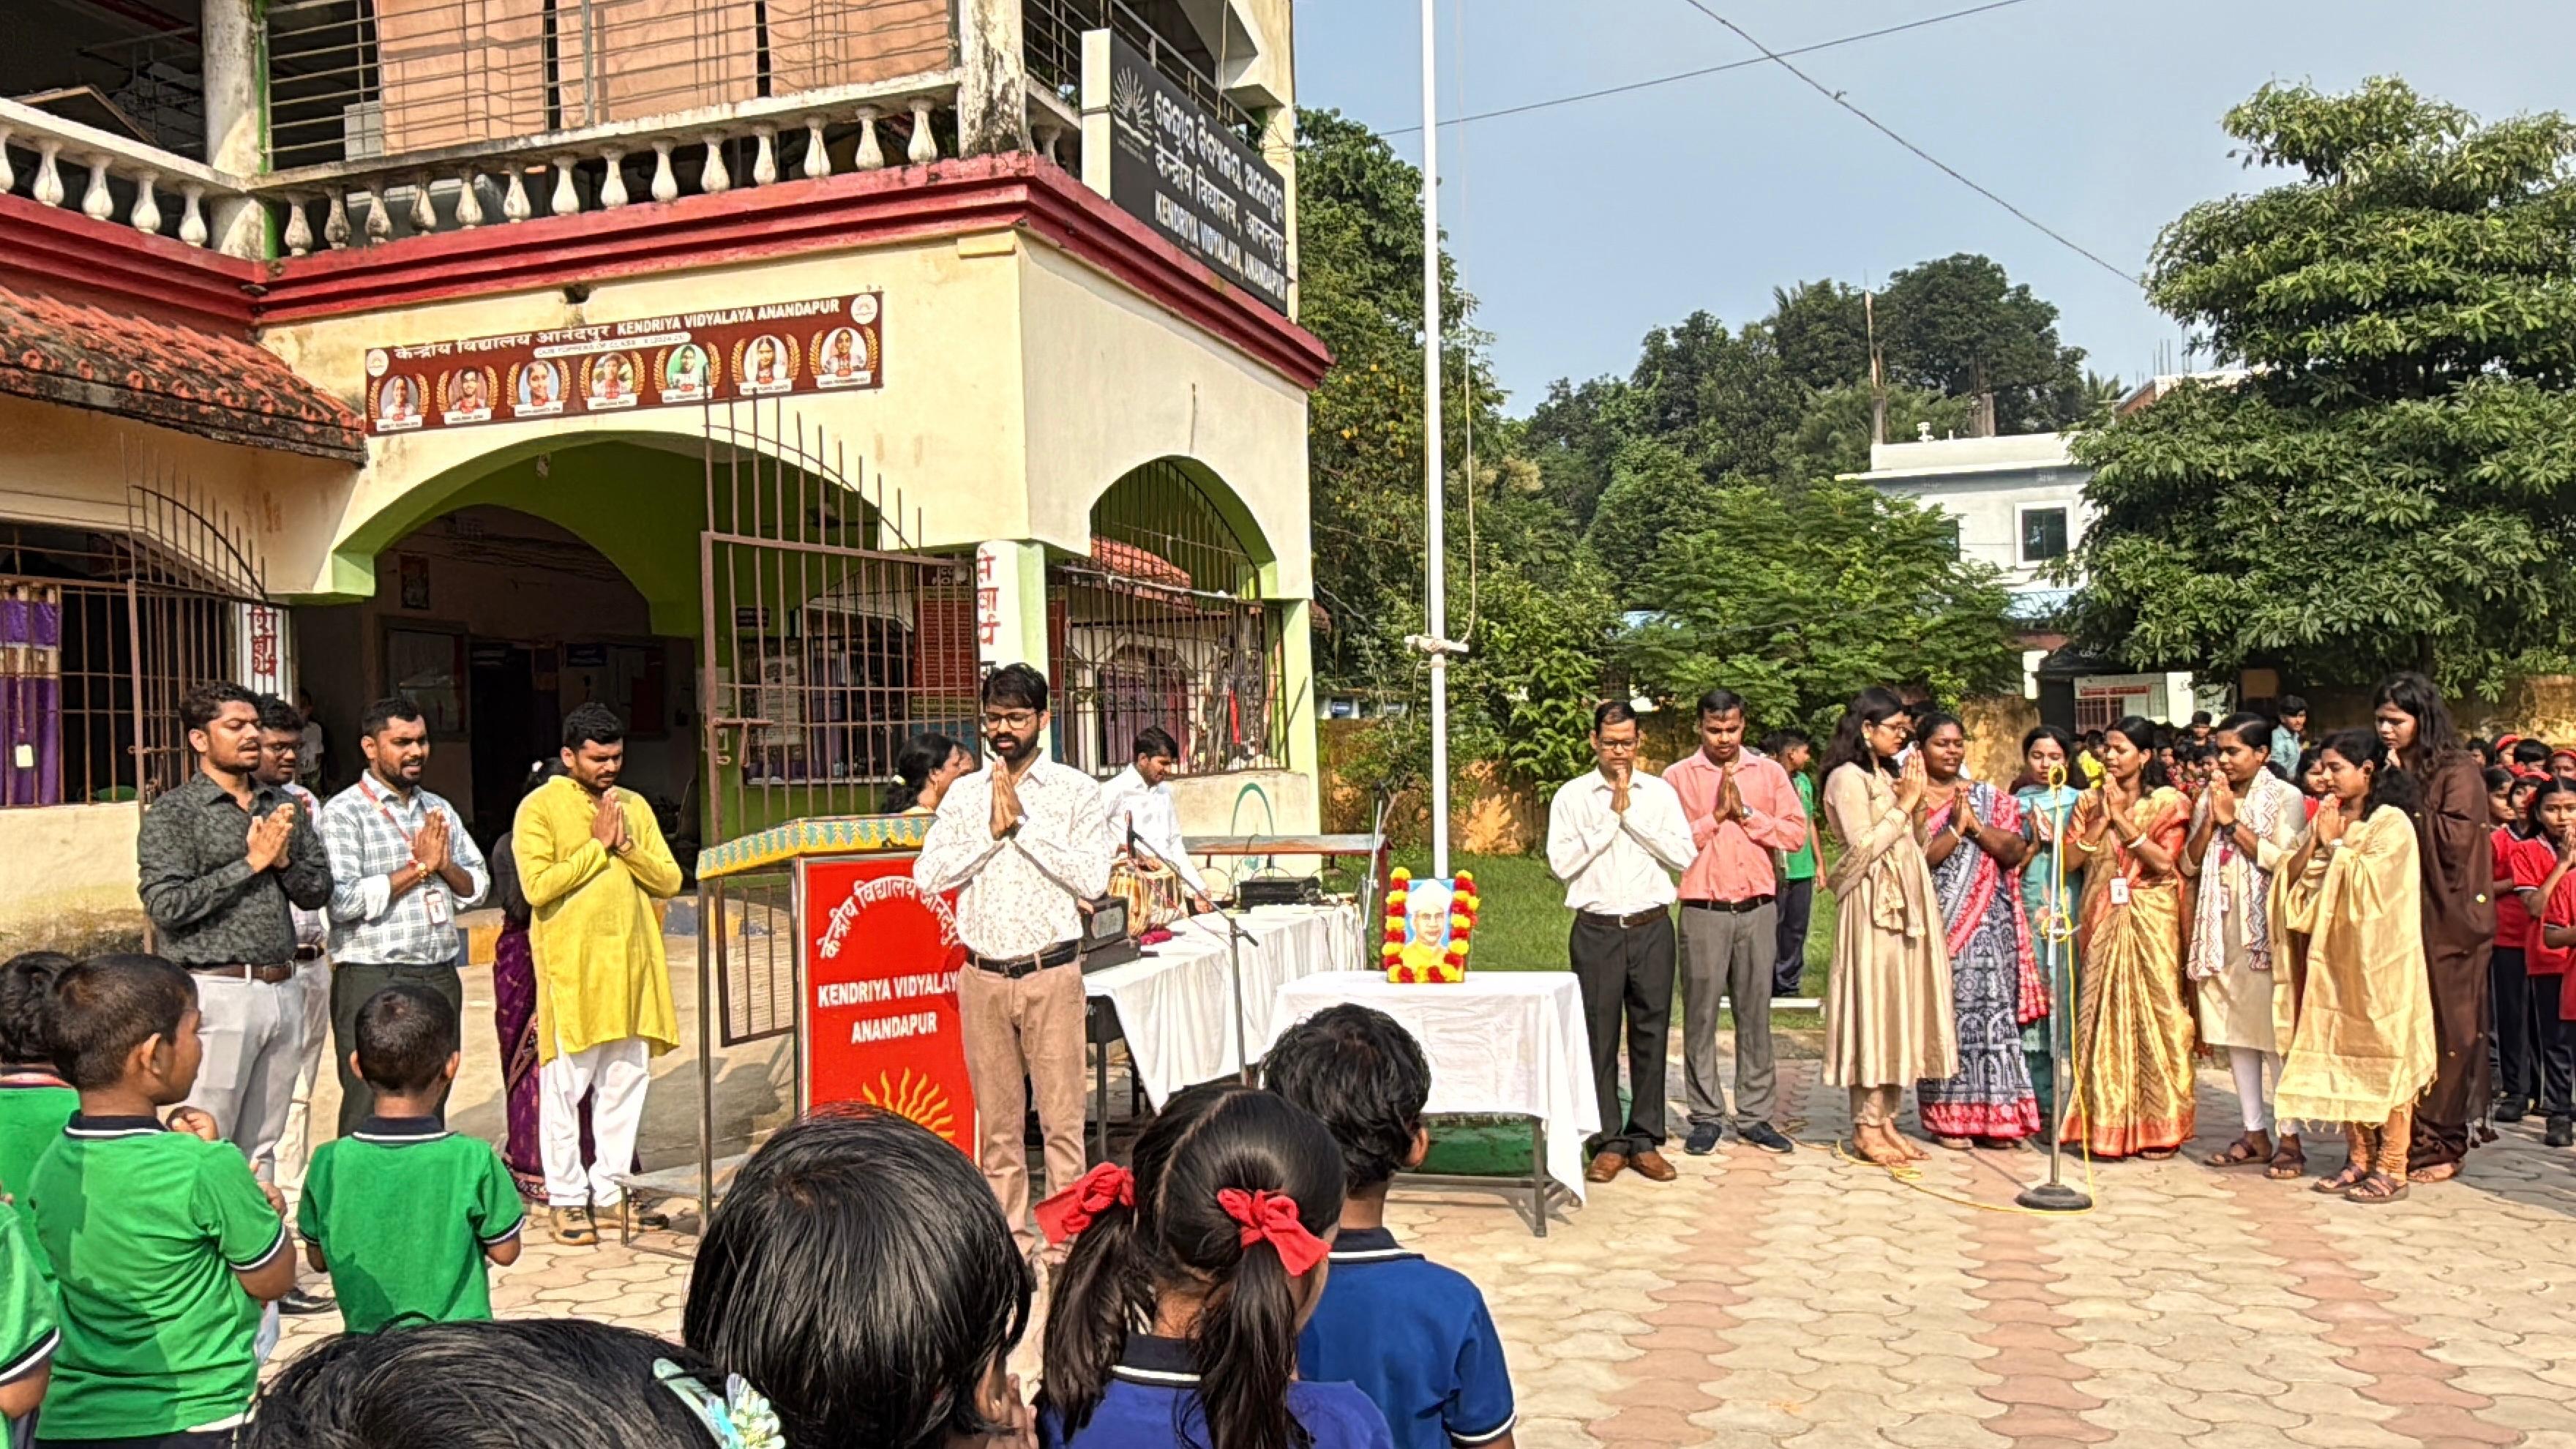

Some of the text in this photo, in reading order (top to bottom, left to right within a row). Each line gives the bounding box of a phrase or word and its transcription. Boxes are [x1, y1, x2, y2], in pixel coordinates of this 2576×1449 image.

[1155, 190, 1199, 247] KENDRIYA
[1244, 250, 1287, 302] ANANDAPUR
[617, 299, 840, 335] KENDRIYA VIDYALAYA ANANDAPUR
[457, 334, 532, 353] विद्यालय
[536, 326, 610, 342] आनंदपुर
[854, 875, 916, 908] विद्यालय
[817, 970, 959, 1008] KENDRIYA VIDYALAY
[851, 1011, 937, 1045] ANANDAPUR
